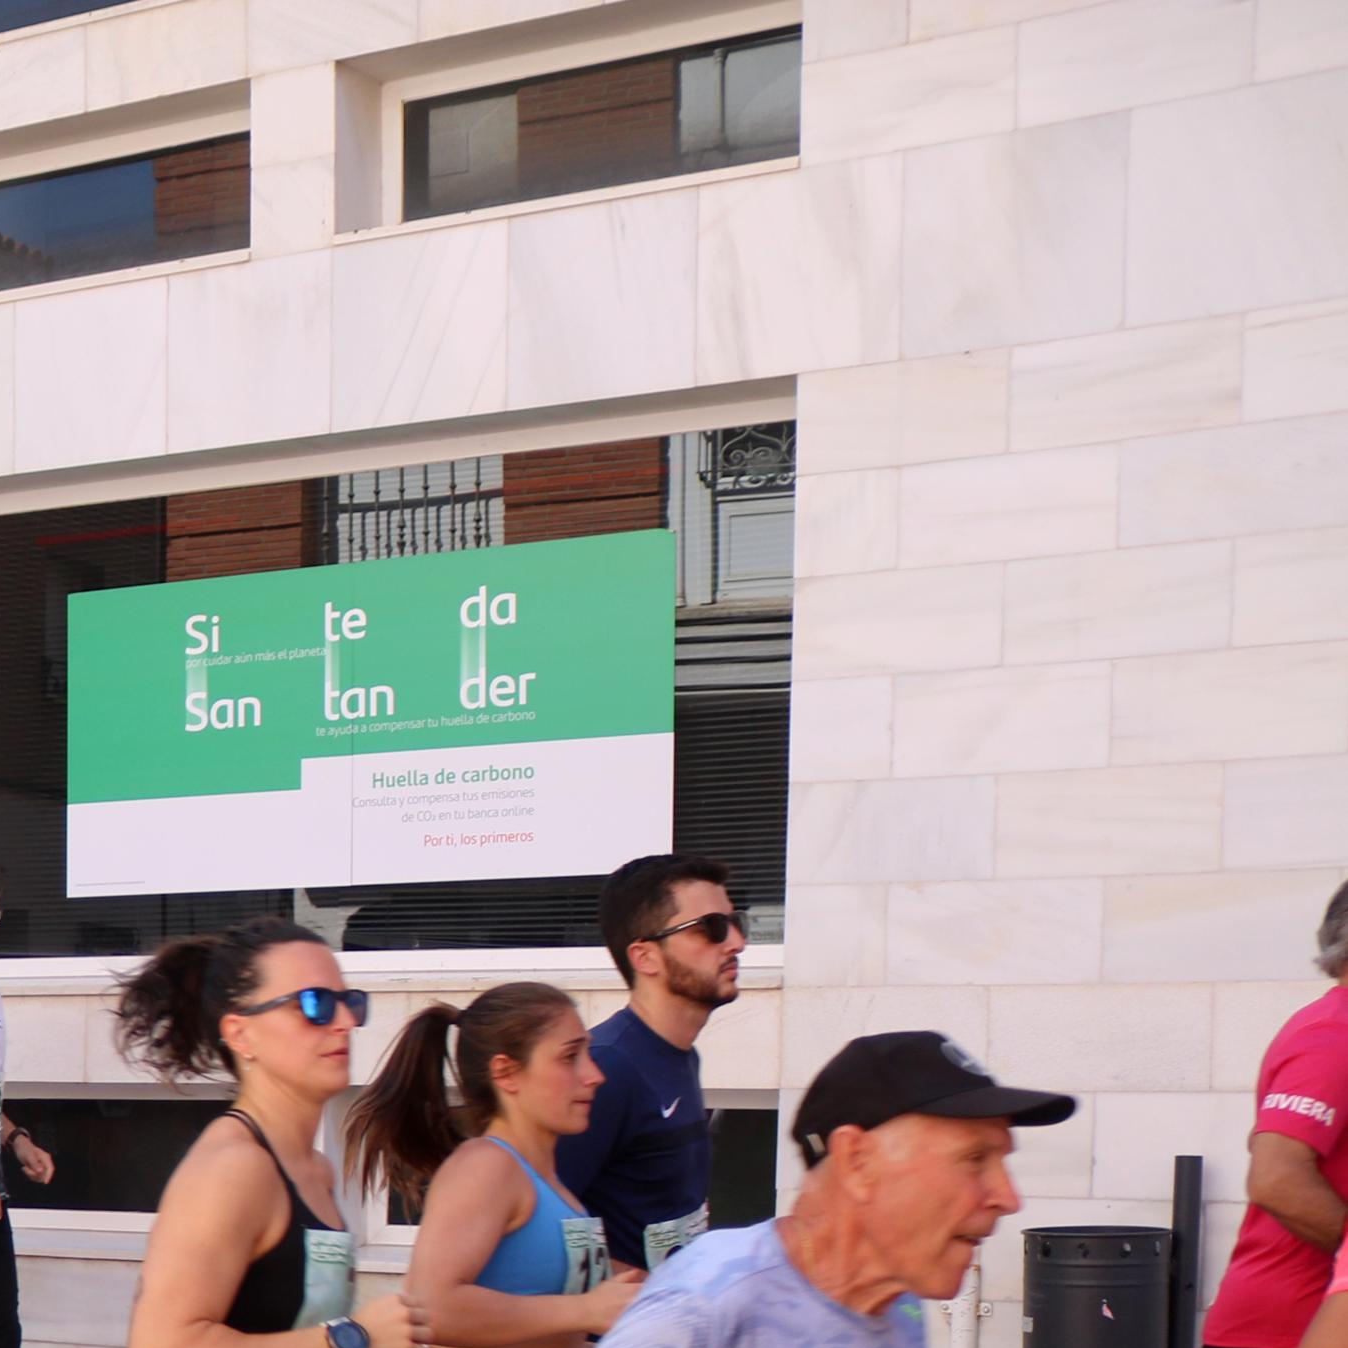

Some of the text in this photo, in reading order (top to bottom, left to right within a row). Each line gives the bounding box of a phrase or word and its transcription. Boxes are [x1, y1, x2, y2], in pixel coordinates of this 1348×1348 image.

[185, 585, 517, 655] Si te da
[203, 654, 233, 666] cuidar
[234, 652, 253, 664] aún
[254, 650, 276, 662] más
[277, 648, 288, 660] el
[289, 647, 327, 661] planeta
[185, 668, 537, 732] San tan der
[316, 726, 328, 737] te
[328, 722, 359, 738] ayuda
[369, 719, 426, 733] compensar
[427, 717, 439, 729] tu
[440, 714, 474, 727] huella
[476, 712, 490, 724] de
[492, 709, 536, 723] carbono
[372, 764, 535, 789] Huella de carbono
[351, 795, 397, 808] Consulta
[407, 793, 460, 807] compensa
[462, 791, 479, 802] tus
[481, 788, 535, 800] emisiones
[401, 811, 415, 823] de
[439, 811, 452, 821] en
[454, 809, 465, 820] tu
[467, 807, 499, 819] banca
[501, 805, 535, 817] online
[423, 834, 443, 847] Por
[460, 832, 477, 845] los
[480, 830, 534, 847] primeros
